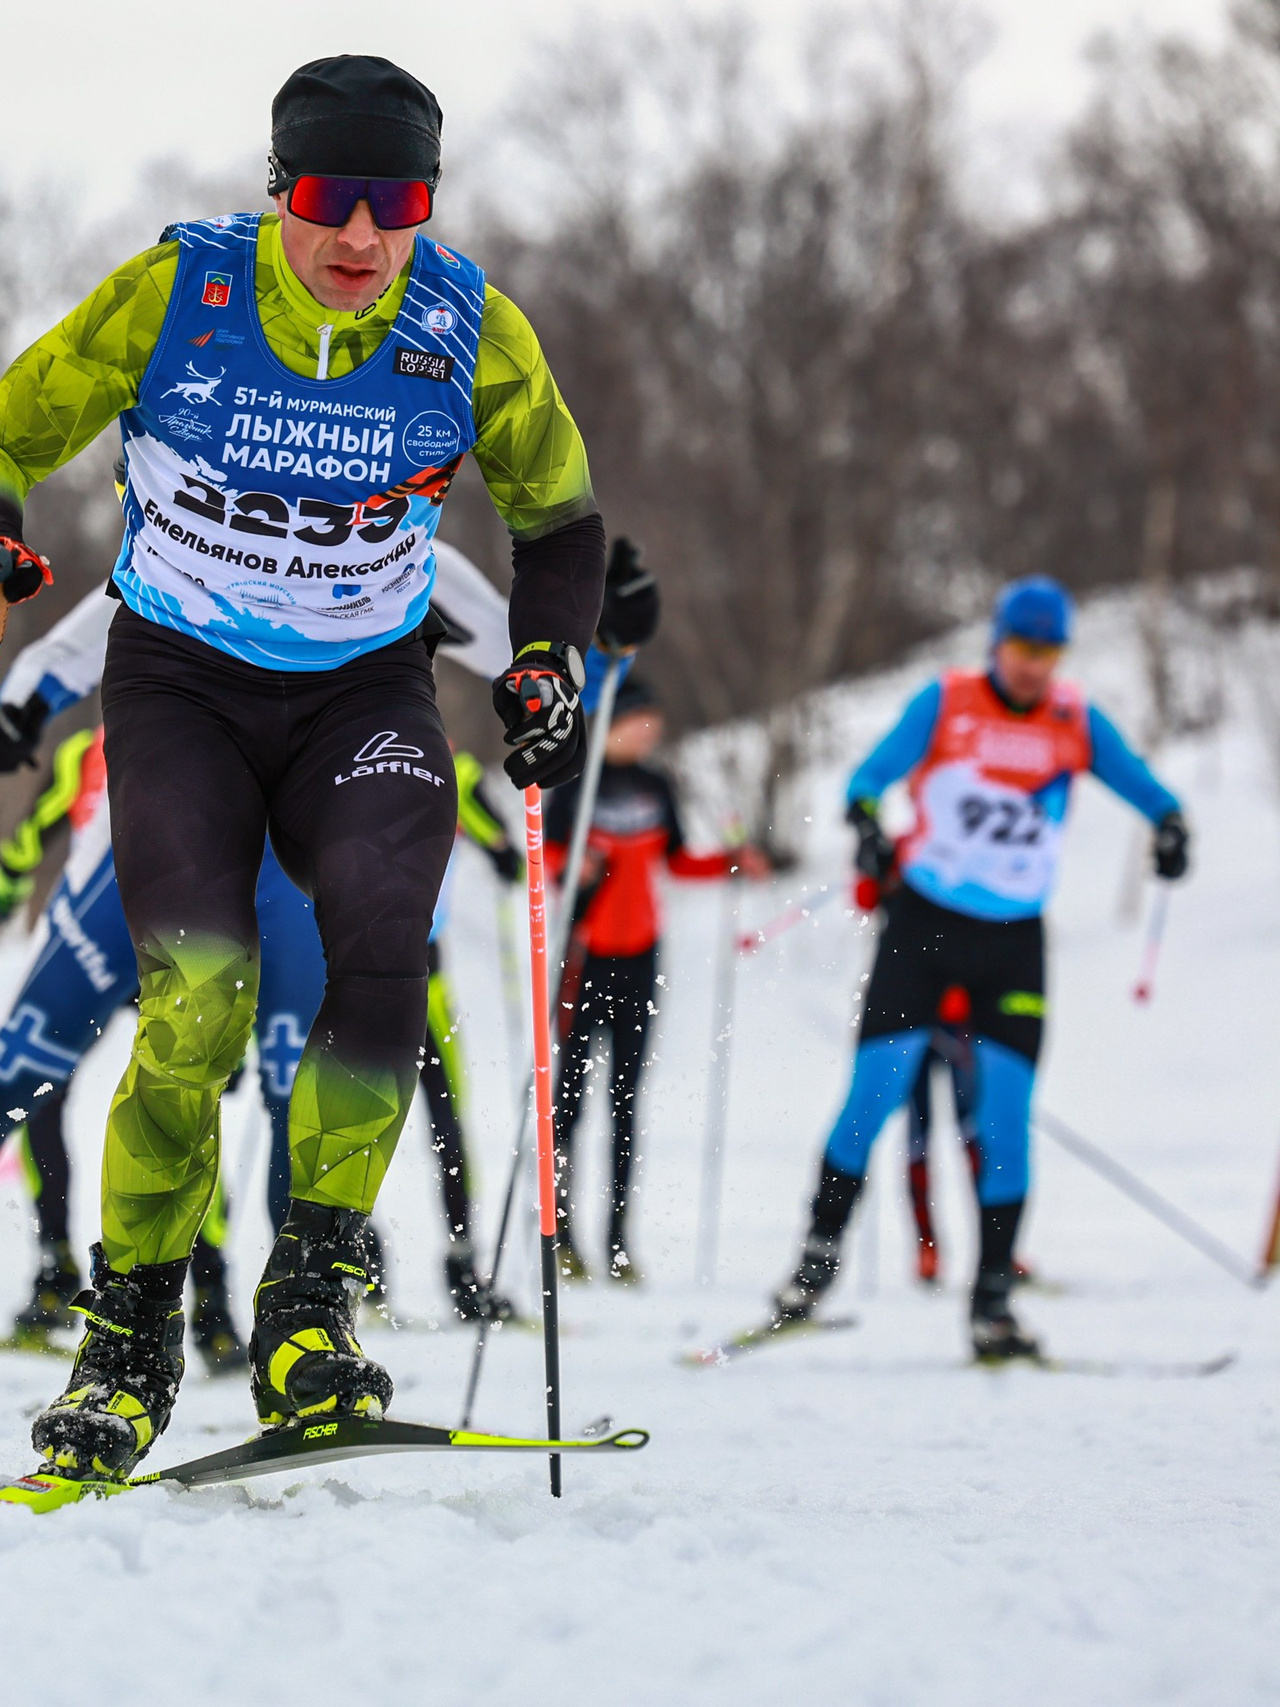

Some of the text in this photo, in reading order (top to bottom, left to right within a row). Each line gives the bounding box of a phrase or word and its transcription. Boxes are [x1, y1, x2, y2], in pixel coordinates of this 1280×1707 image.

[400, 351, 446, 370] RUSSIA
[286, 398, 396, 422] МУРМАНСКИЙ
[225, 413, 395, 457] ЛЫЖНЫЙ
[417, 425, 433, 437] 25
[221, 442, 391, 483] МАРАФОН
[144, 498, 277, 575] Емельянов
[284, 532, 416, 579] Александр
[524, 800, 543, 851] WA
[331, 1261, 368, 1279] FISCH
[302, 1422, 338, 1441] FISCHER
